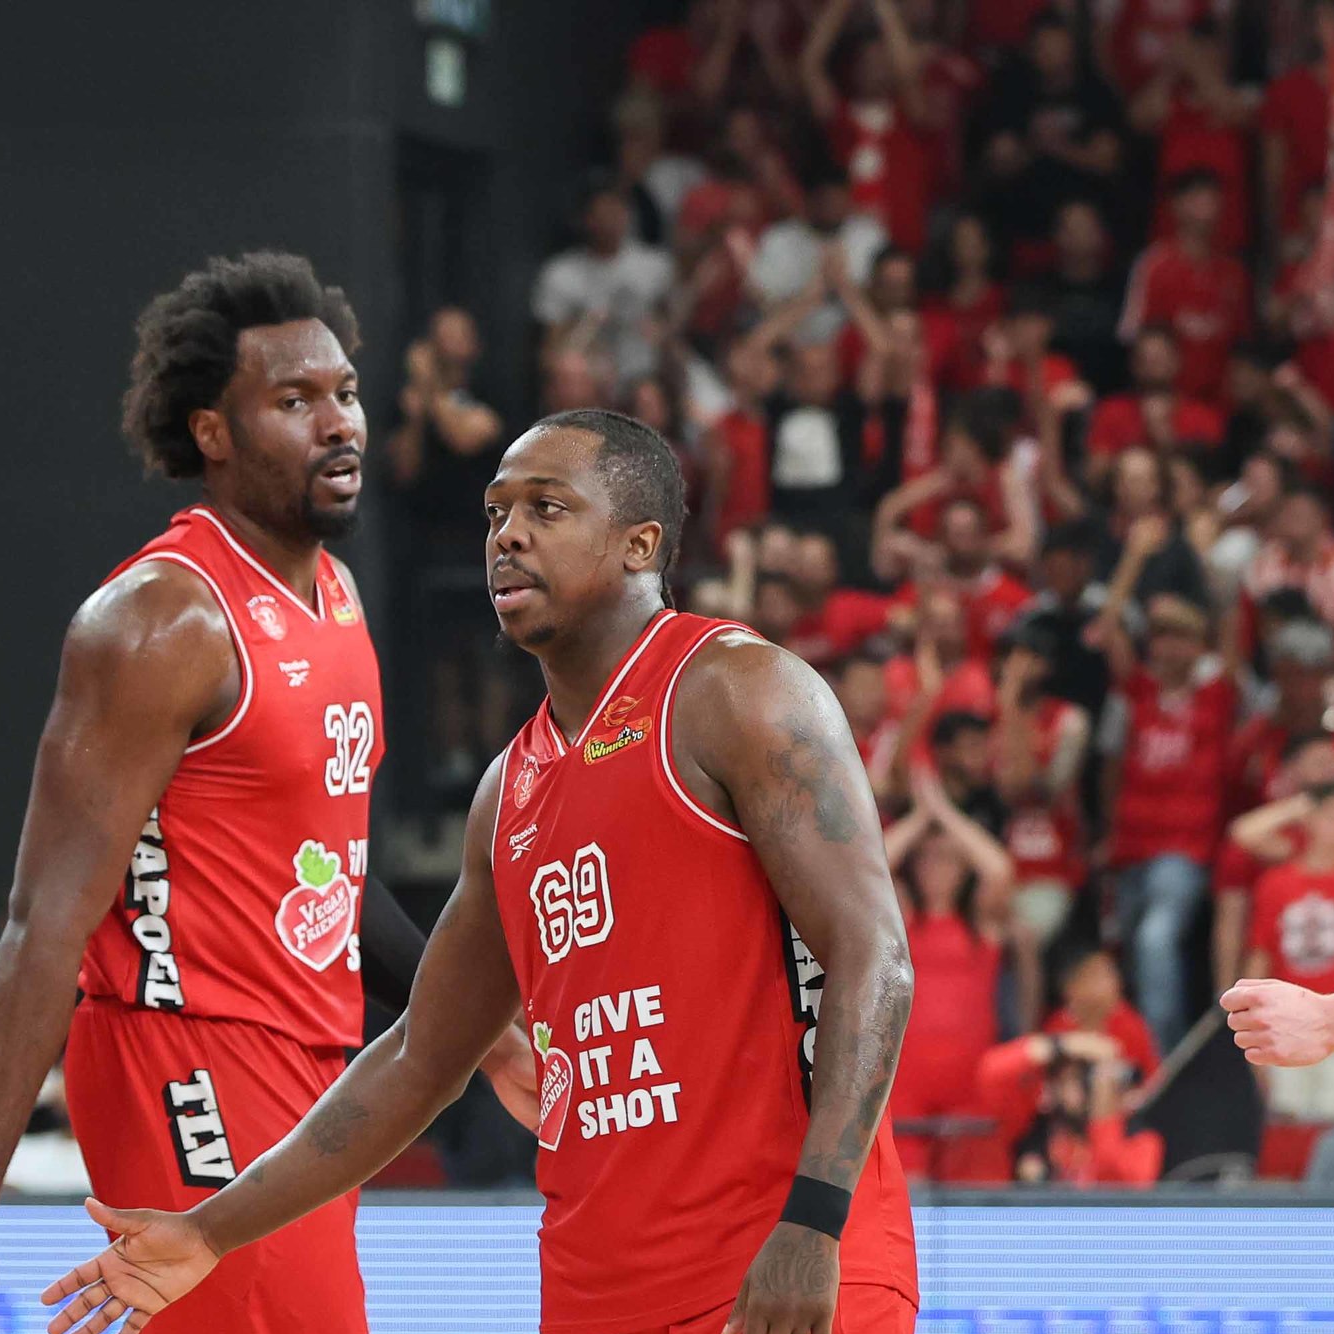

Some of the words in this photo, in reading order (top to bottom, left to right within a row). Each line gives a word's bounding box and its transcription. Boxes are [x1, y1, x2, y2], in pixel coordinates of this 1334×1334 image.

[324, 701, 374, 797] 32
[590, 735, 632, 759] Winner
[130, 806, 185, 1008] APOEL
[530, 842, 614, 964] 69
[574, 985, 664, 1042] GIVE
[579, 1045, 612, 1089] IT
[630, 1038, 662, 1080] A
[169, 1069, 236, 1180] TLV
[577, 1082, 681, 1139] SHOT
